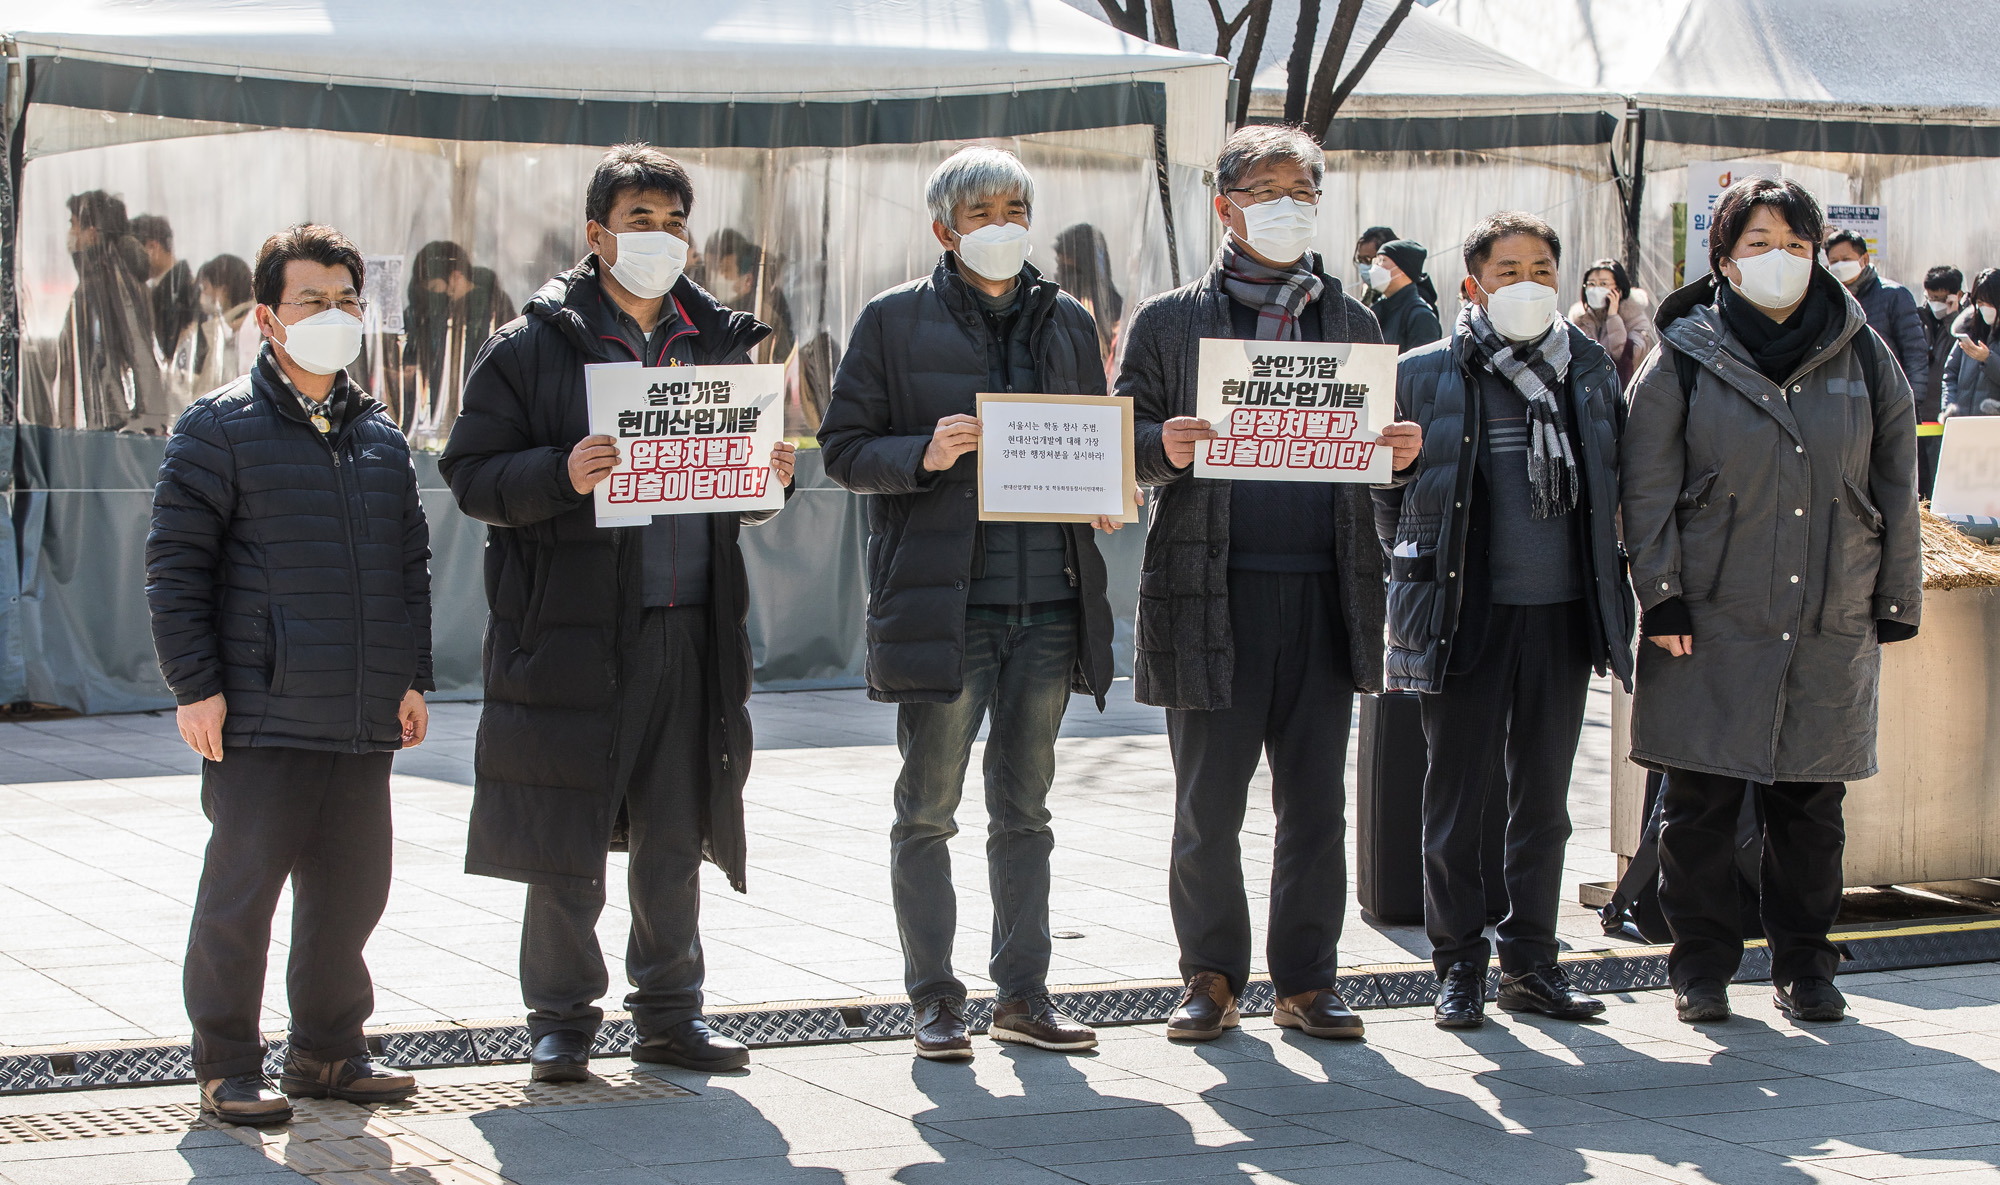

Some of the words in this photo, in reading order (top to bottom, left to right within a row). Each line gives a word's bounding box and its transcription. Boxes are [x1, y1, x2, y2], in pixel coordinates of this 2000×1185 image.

[1251, 354, 1338, 380] 살인기업
[647, 380, 731, 407] 살인기업
[1221, 378, 1370, 409] 현대산업개발
[618, 406, 762, 438] 현대산업개발
[1008, 421, 1040, 431] 서울시는
[1043, 421, 1059, 432] 학동
[1063, 422, 1078, 432] 참사
[1230, 408, 1358, 440] 엄정처벌과
[630, 436, 753, 471] 엄정처벌과
[1002, 449, 1026, 459] 강력한
[1030, 449, 1069, 460] 행정처분을
[1072, 450, 1105, 461] 실시하라!
[1007, 435, 1063, 446] 현대산업개발에
[1066, 436, 1081, 446] 대해
[1084, 437, 1099, 447] 가장
[1206, 437, 1287, 468] 퇴출이
[1286, 438, 1376, 471] 답이다!
[608, 469, 688, 504] 퇴출이
[691, 467, 770, 499] 답이다!
